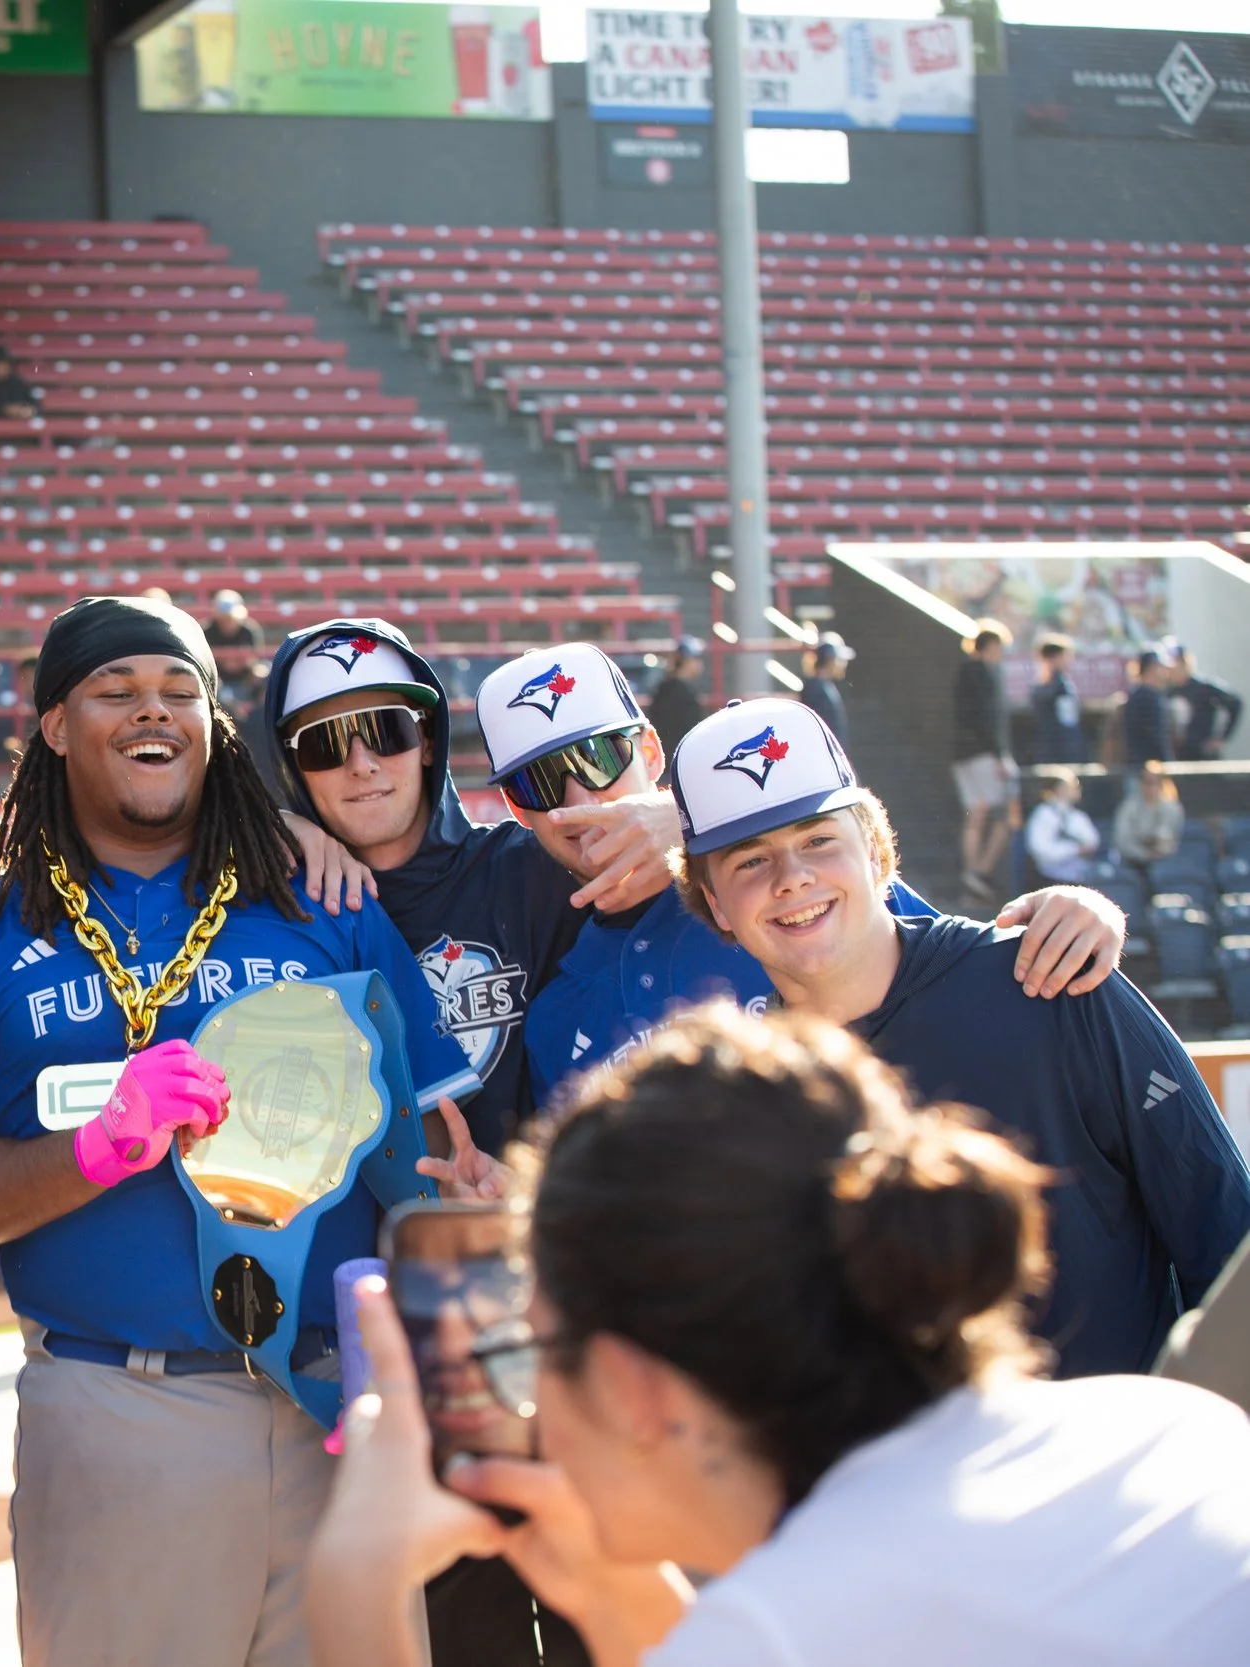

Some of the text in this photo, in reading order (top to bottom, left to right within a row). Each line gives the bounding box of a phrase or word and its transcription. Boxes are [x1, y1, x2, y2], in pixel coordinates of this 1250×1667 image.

[594, 12, 668, 39] TIME
[747, 17, 792, 42] RY
[267, 20, 422, 78] HOYNE
[596, 42, 616, 67] A
[594, 73, 690, 99] LIGHT
